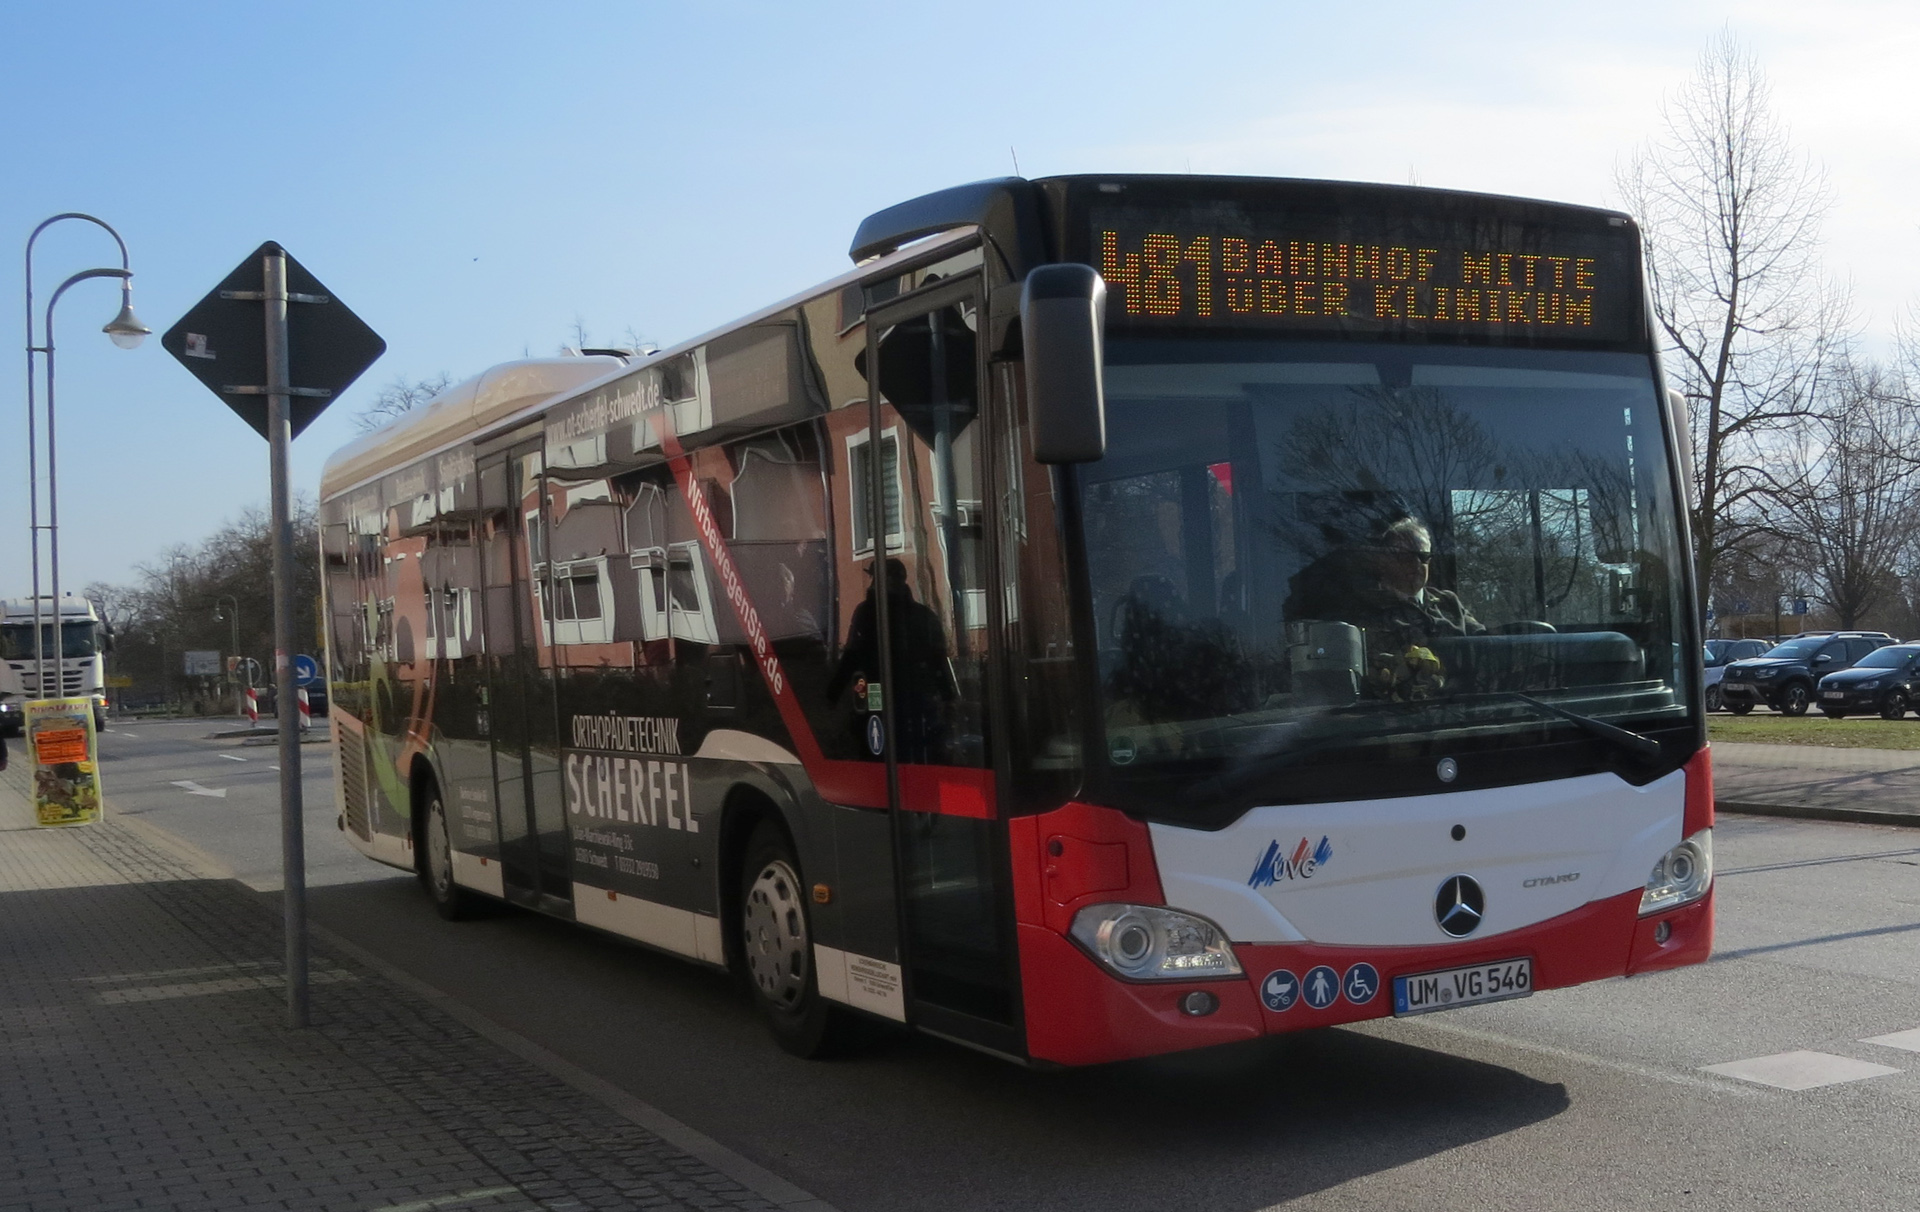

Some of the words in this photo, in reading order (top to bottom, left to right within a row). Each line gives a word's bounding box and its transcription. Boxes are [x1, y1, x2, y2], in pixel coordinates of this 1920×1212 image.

[1103, 231, 1211, 316] 481
[1222, 237, 1438, 282] BAHNHOF
[1463, 250, 1595, 290] MITTE
[1227, 277, 1349, 316] ÜBER
[1375, 285, 1592, 326] KLINIKUM
[687, 471, 783, 695] WirbewegenSie.de
[572, 710, 681, 754] ORTHOPÄDIETECHNIK
[567, 753, 699, 833] SCHERFEL
[1272, 857, 1317, 881] UVG
[1522, 873, 1580, 888] CITARO
[1409, 977, 1439, 1006] UM
[1454, 971, 1483, 998] VG
[1489, 964, 1529, 994] 546
